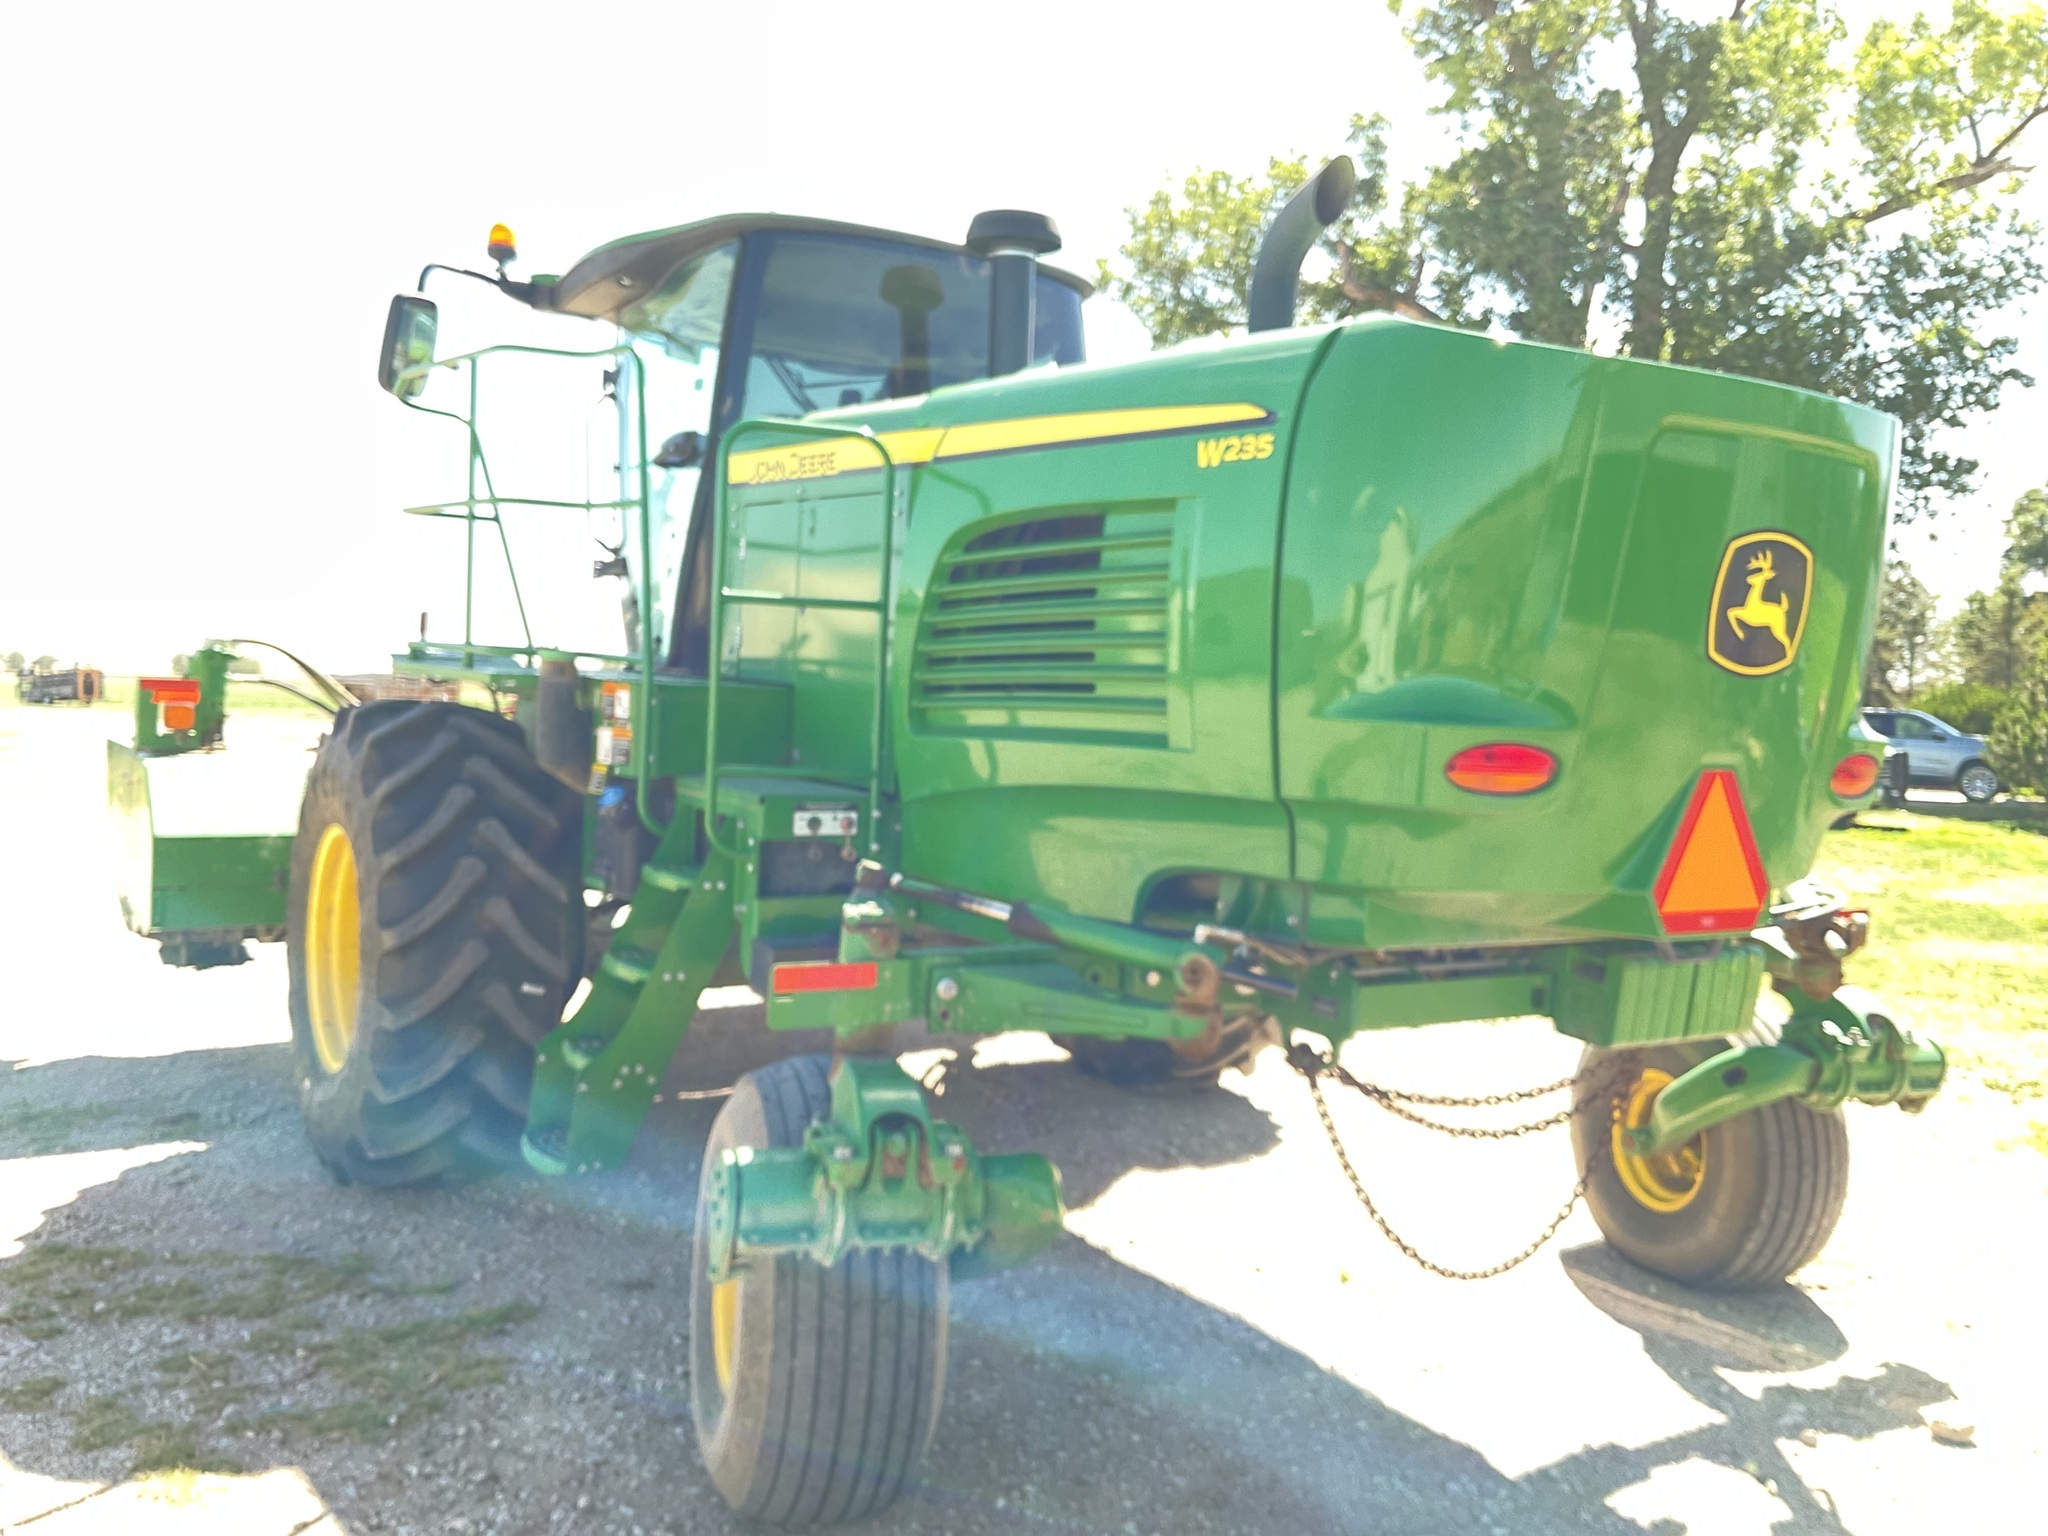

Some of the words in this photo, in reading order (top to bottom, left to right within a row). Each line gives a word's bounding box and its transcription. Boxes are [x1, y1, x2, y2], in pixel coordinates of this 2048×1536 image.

[748, 458, 787, 485] JOHN
[788, 451, 837, 479] DEERE
[1196, 432, 1276, 469] W235
